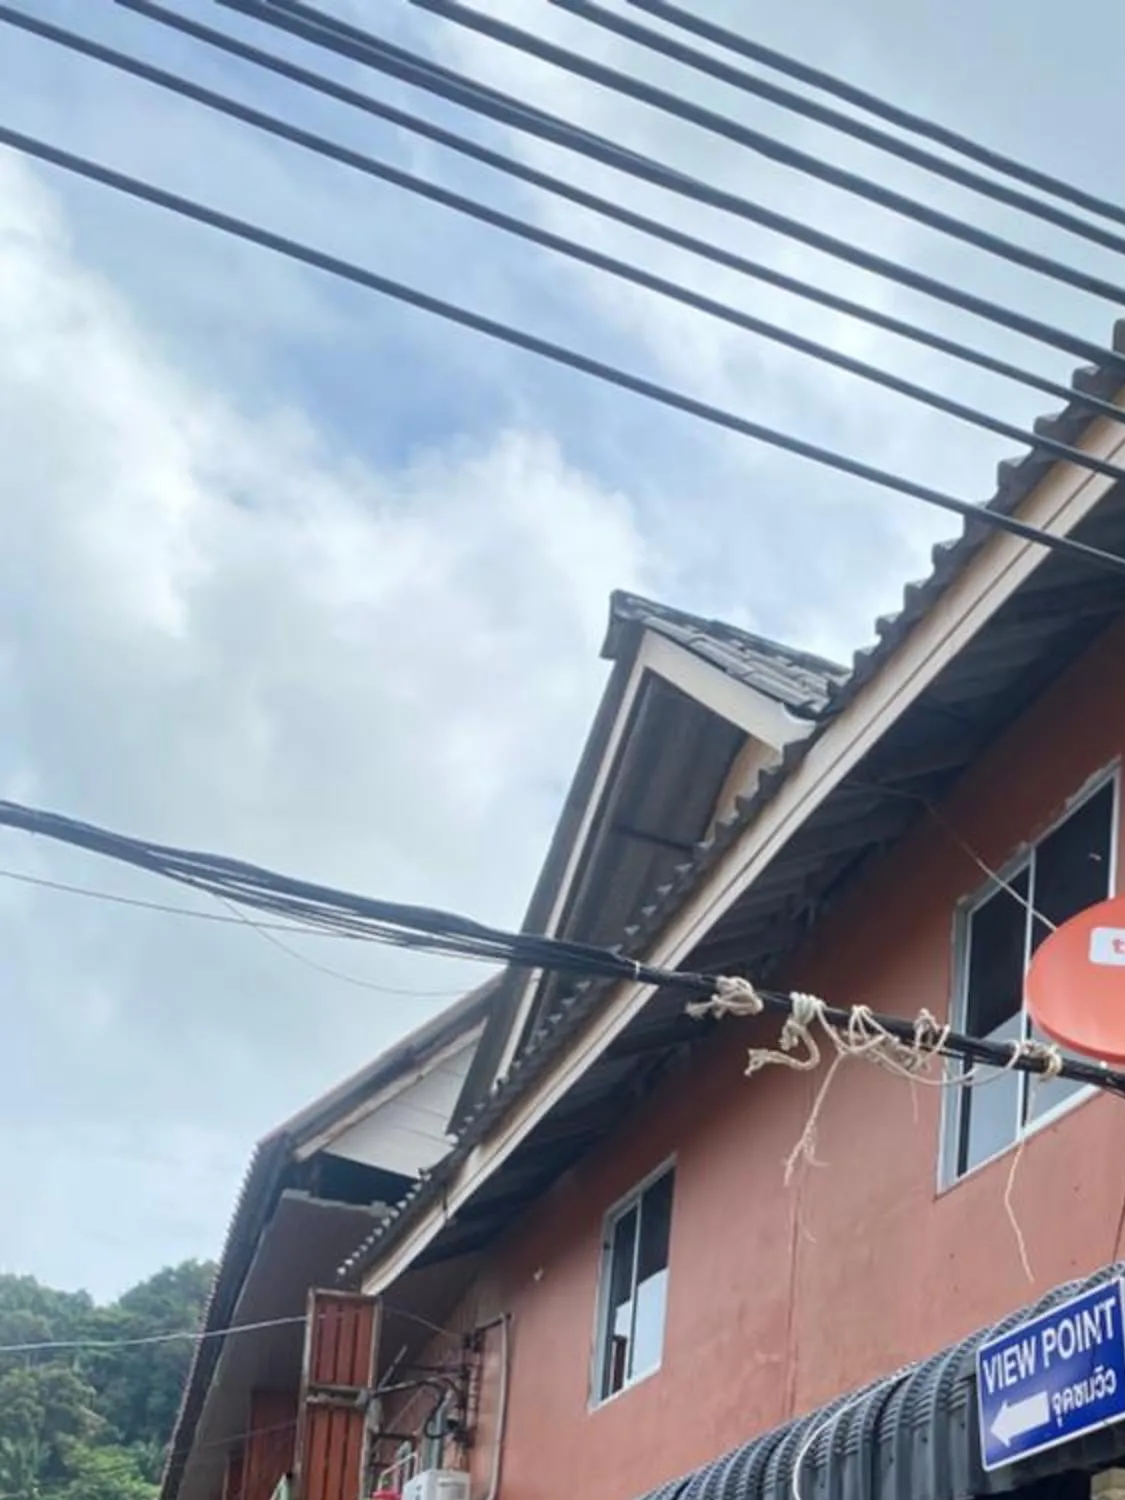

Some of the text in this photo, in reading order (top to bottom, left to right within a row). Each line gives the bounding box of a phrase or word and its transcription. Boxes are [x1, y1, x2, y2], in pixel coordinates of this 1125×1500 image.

[982, 1295, 1117, 1396] VIEW POINT
[1051, 1364, 1118, 1429] จุดชมวิว
